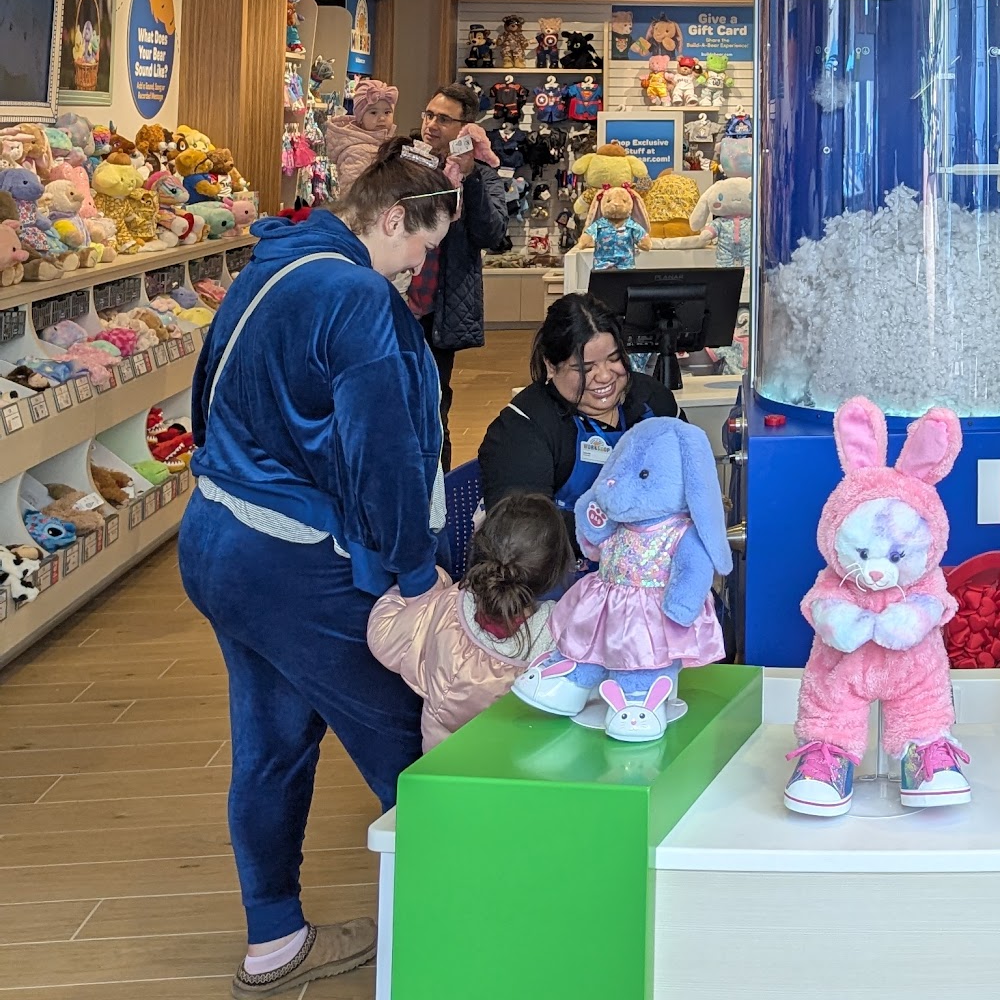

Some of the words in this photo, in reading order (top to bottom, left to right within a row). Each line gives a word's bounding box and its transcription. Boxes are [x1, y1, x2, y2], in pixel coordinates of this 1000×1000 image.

[698, 13, 726, 24] Give
[730, 15, 738, 24] a
[138, 28, 154, 43] What
[155, 30, 168, 45] Does
[688, 25, 713, 36] Gift
[716, 25, 747, 36] Card
[139, 45, 152, 60] Your
[153, 47, 166, 61] Bear
[135, 62, 152, 77] Sound
[154, 64, 168, 78] Like?
